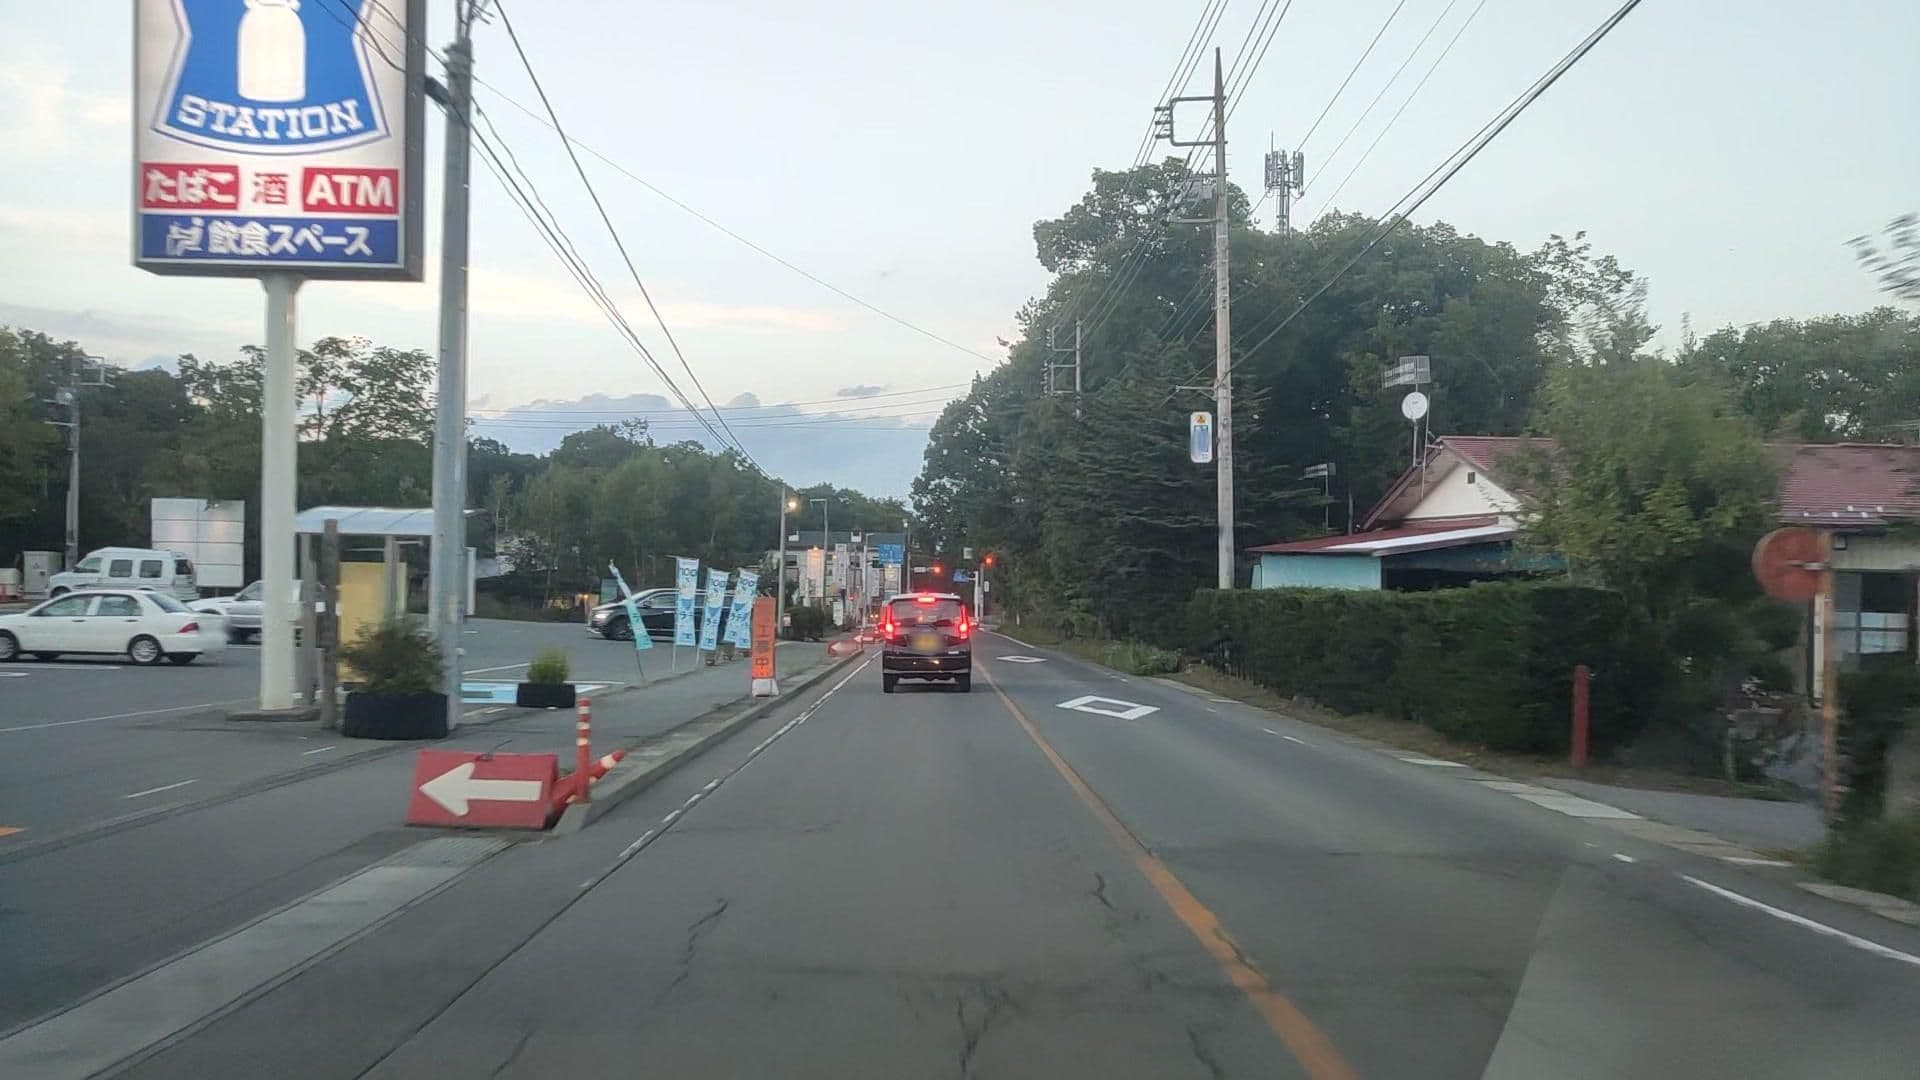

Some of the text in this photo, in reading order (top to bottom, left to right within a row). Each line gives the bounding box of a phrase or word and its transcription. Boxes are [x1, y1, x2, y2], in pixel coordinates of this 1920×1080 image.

[177, 94, 364, 140] STATION
[145, 169, 238, 204] たばこ
[252, 172, 289, 205] 酒
[306, 174, 393, 208] ATM
[207, 219, 373, 256] 飲食スペース
[755, 624, 770, 670] 工中
